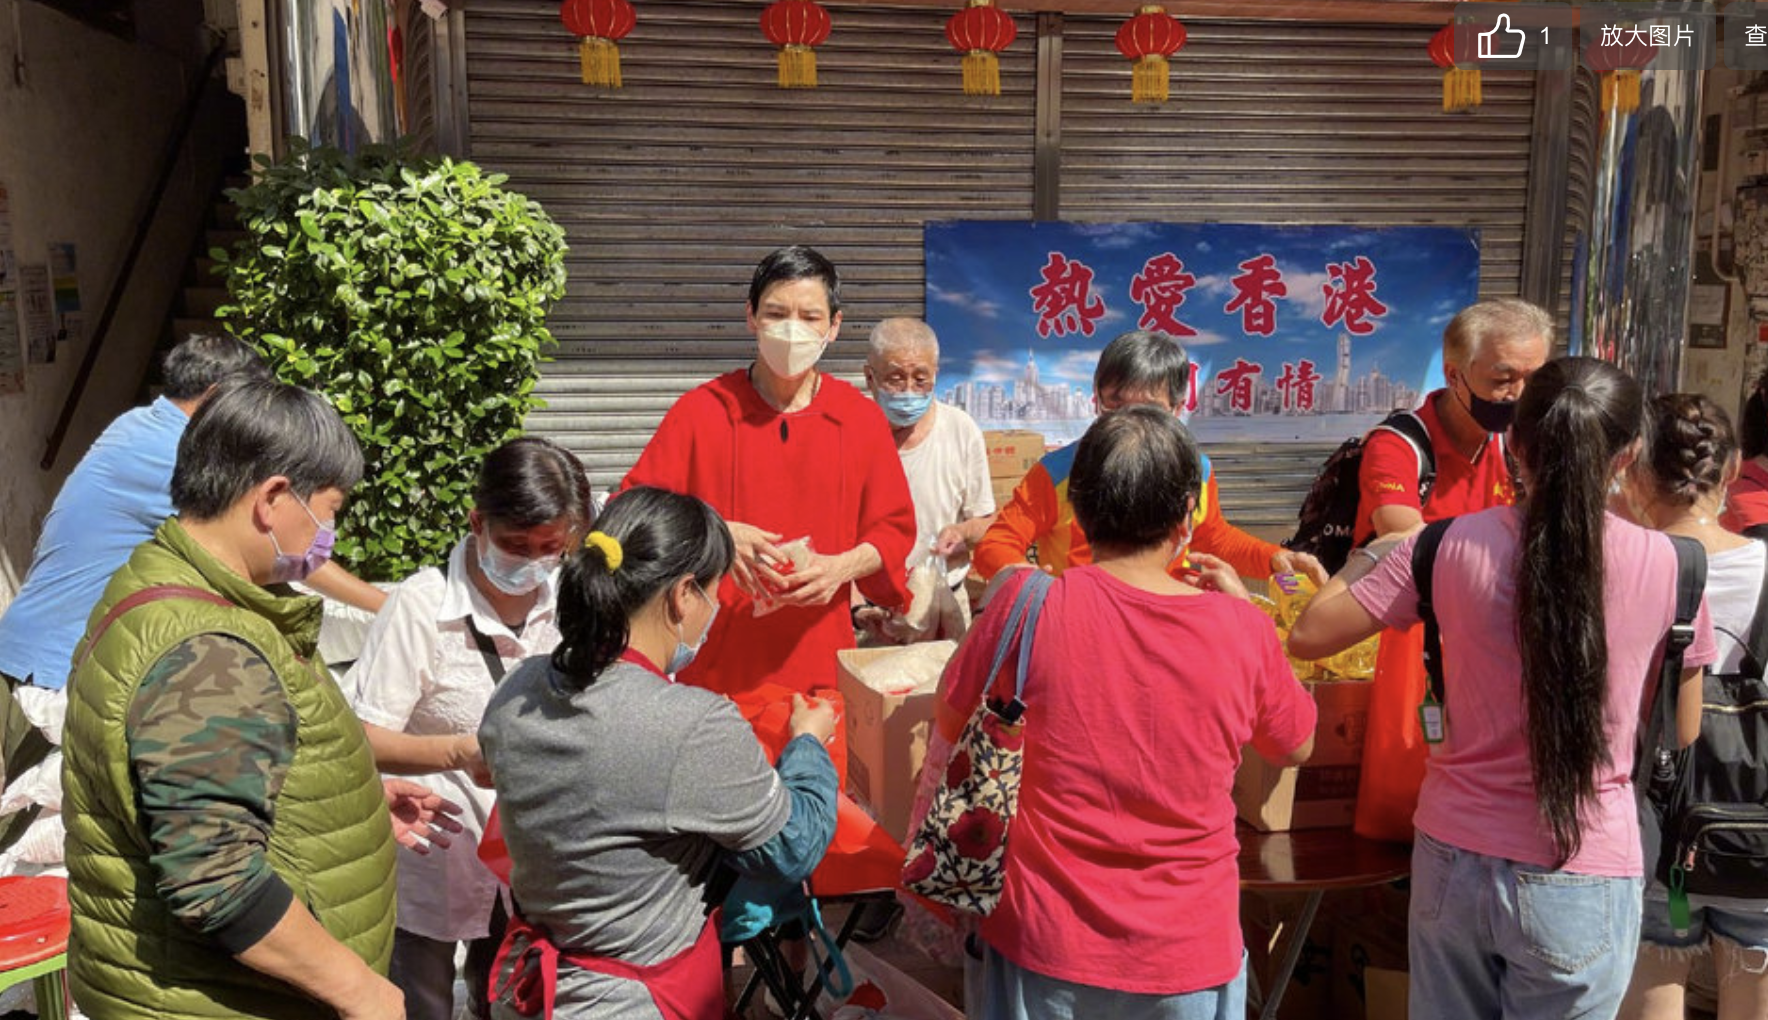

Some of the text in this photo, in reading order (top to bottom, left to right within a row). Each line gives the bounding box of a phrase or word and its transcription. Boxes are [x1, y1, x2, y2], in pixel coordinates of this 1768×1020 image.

[1030, 251, 1389, 339] 熱愛香港
[1183, 359, 1321, 413] 有情
[1323, 523, 1354, 538] OM
